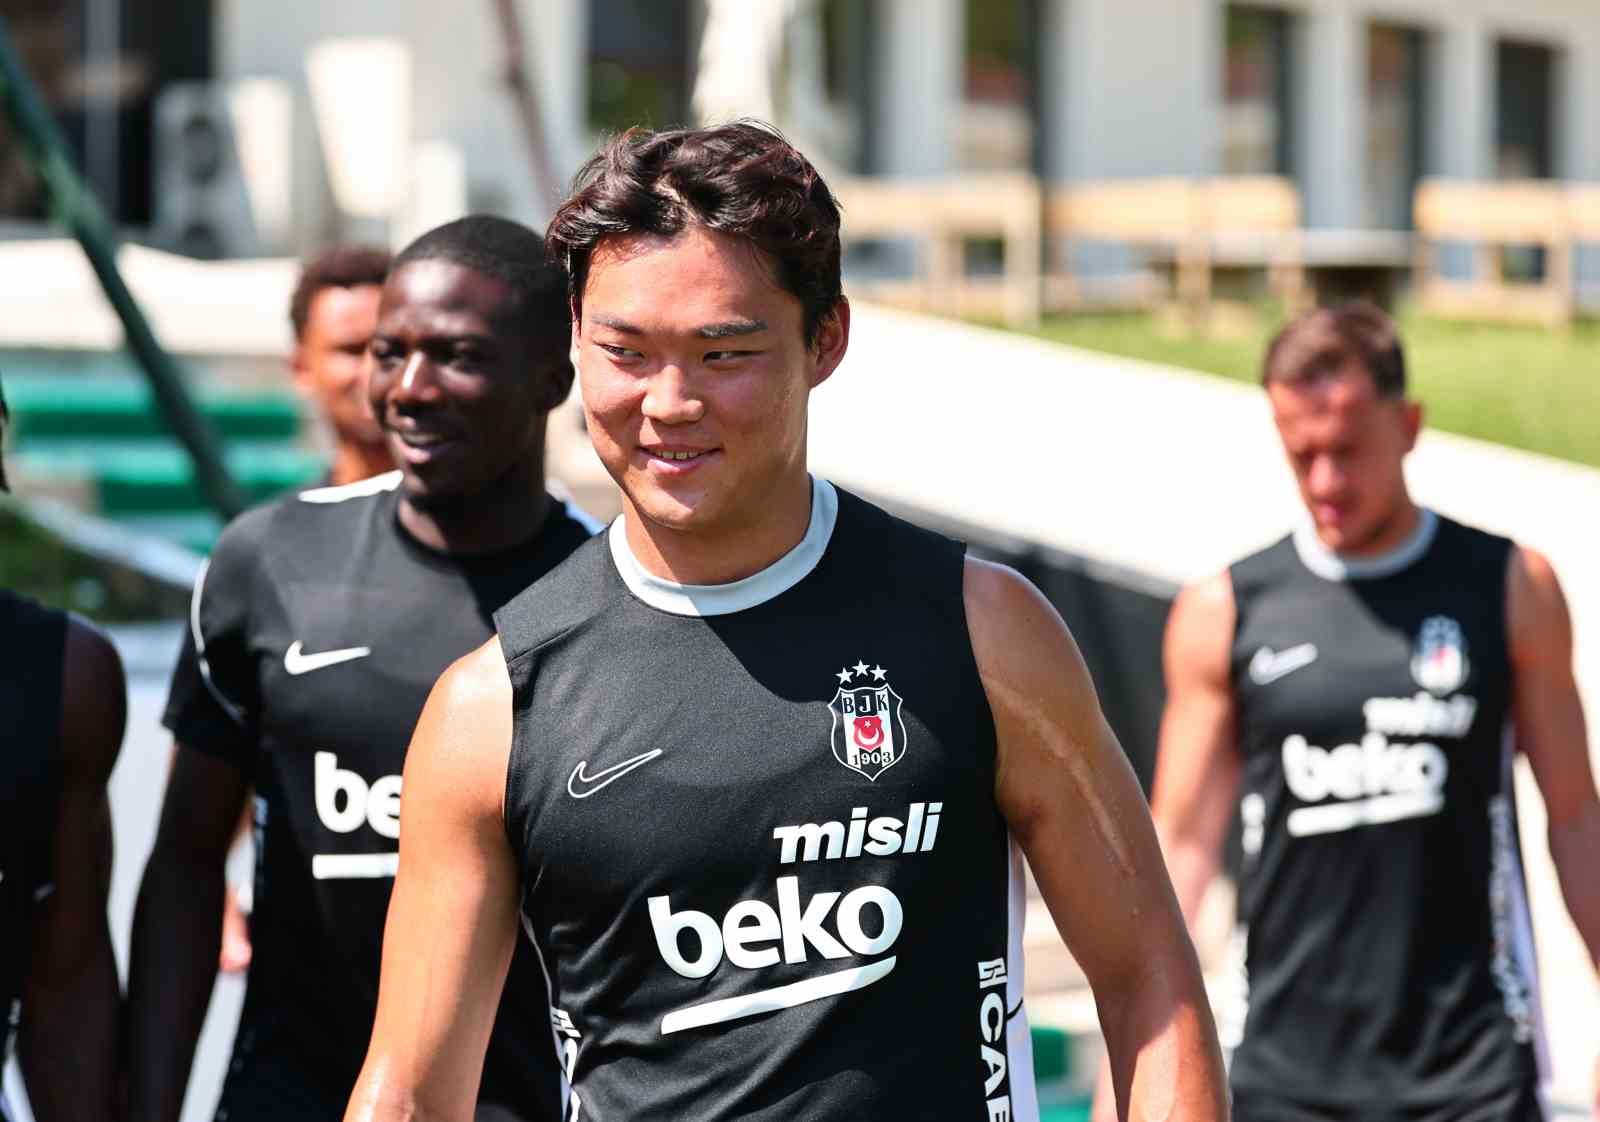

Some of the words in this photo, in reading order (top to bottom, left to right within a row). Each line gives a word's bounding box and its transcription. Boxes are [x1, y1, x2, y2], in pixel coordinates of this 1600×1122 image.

[842, 694, 889, 714] BJK
[852, 751, 892, 766] 1903
[773, 802, 943, 863] misli
[648, 876, 903, 979] beko
